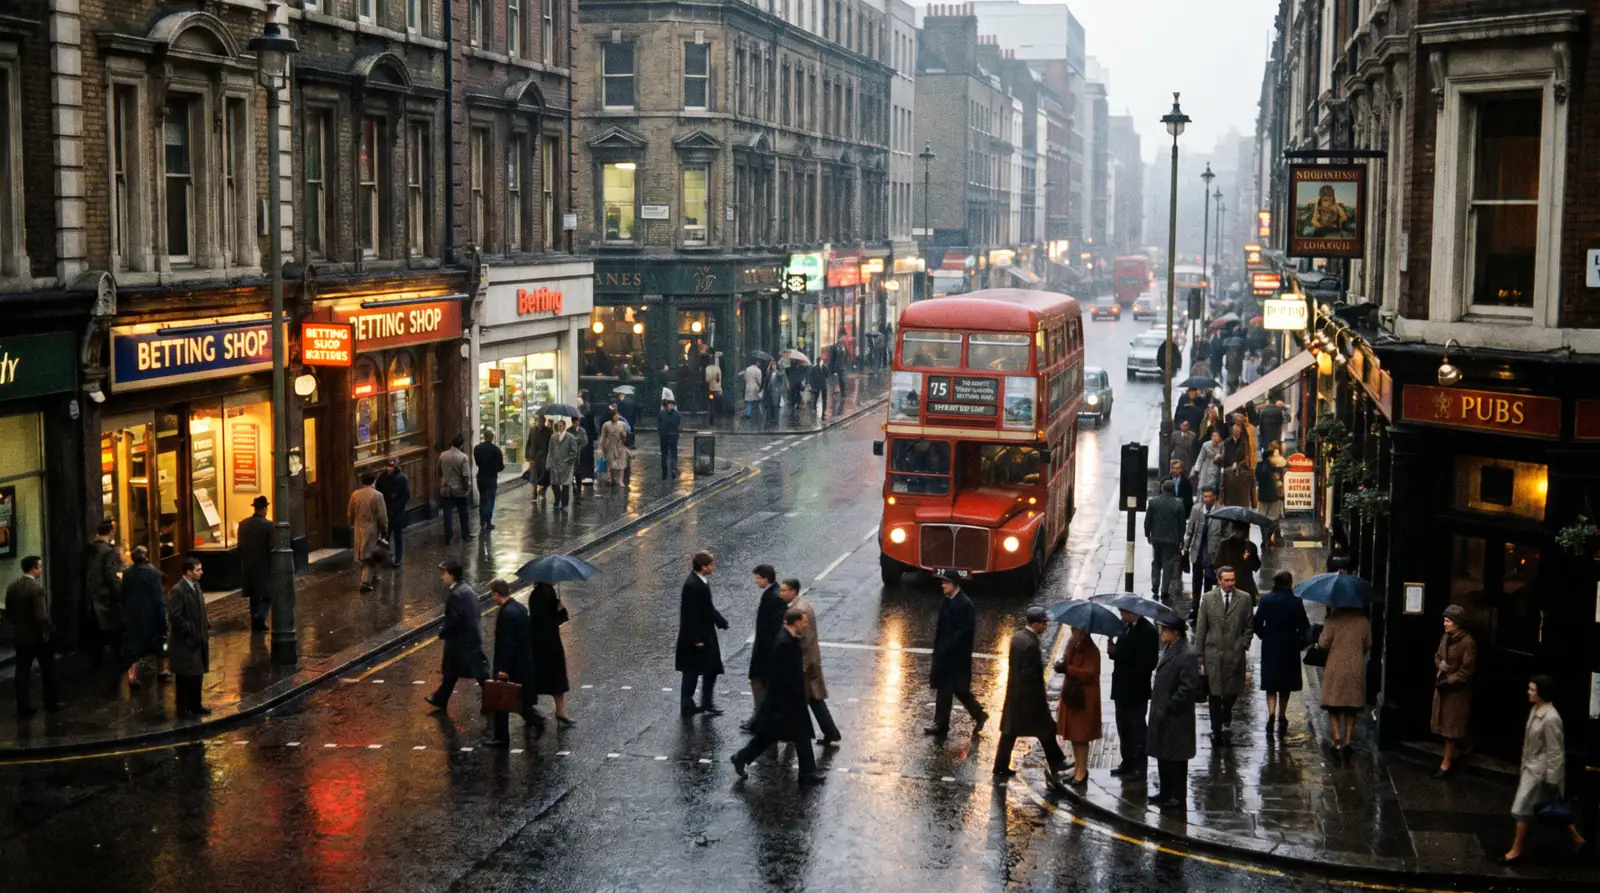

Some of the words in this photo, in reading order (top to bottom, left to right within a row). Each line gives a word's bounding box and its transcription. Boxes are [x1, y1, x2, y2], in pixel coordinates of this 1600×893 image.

[517, 286, 563, 315] Betting
[409, 308, 442, 333] SHOP
[137, 334, 216, 371] BETTING
[223, 329, 268, 361] SHOP
[930, 382, 947, 396] 75
[1460, 395, 1524, 425] PUBS
